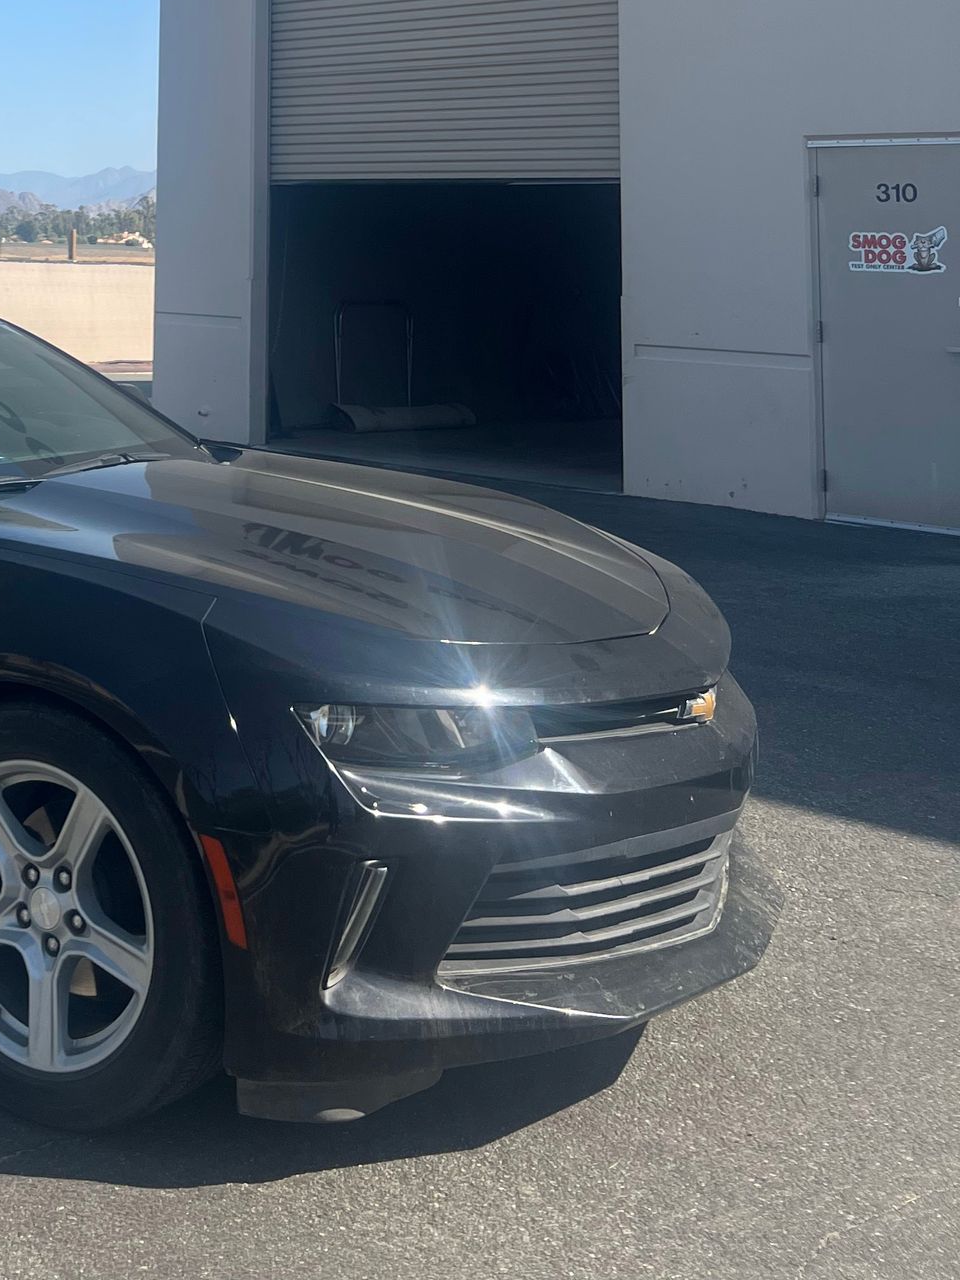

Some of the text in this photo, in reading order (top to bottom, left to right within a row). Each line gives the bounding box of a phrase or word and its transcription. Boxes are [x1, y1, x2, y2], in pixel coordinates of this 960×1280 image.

[876, 183, 918, 202] 310
[851, 234, 907, 250] SMOG
[864, 250, 907, 265] DOG
